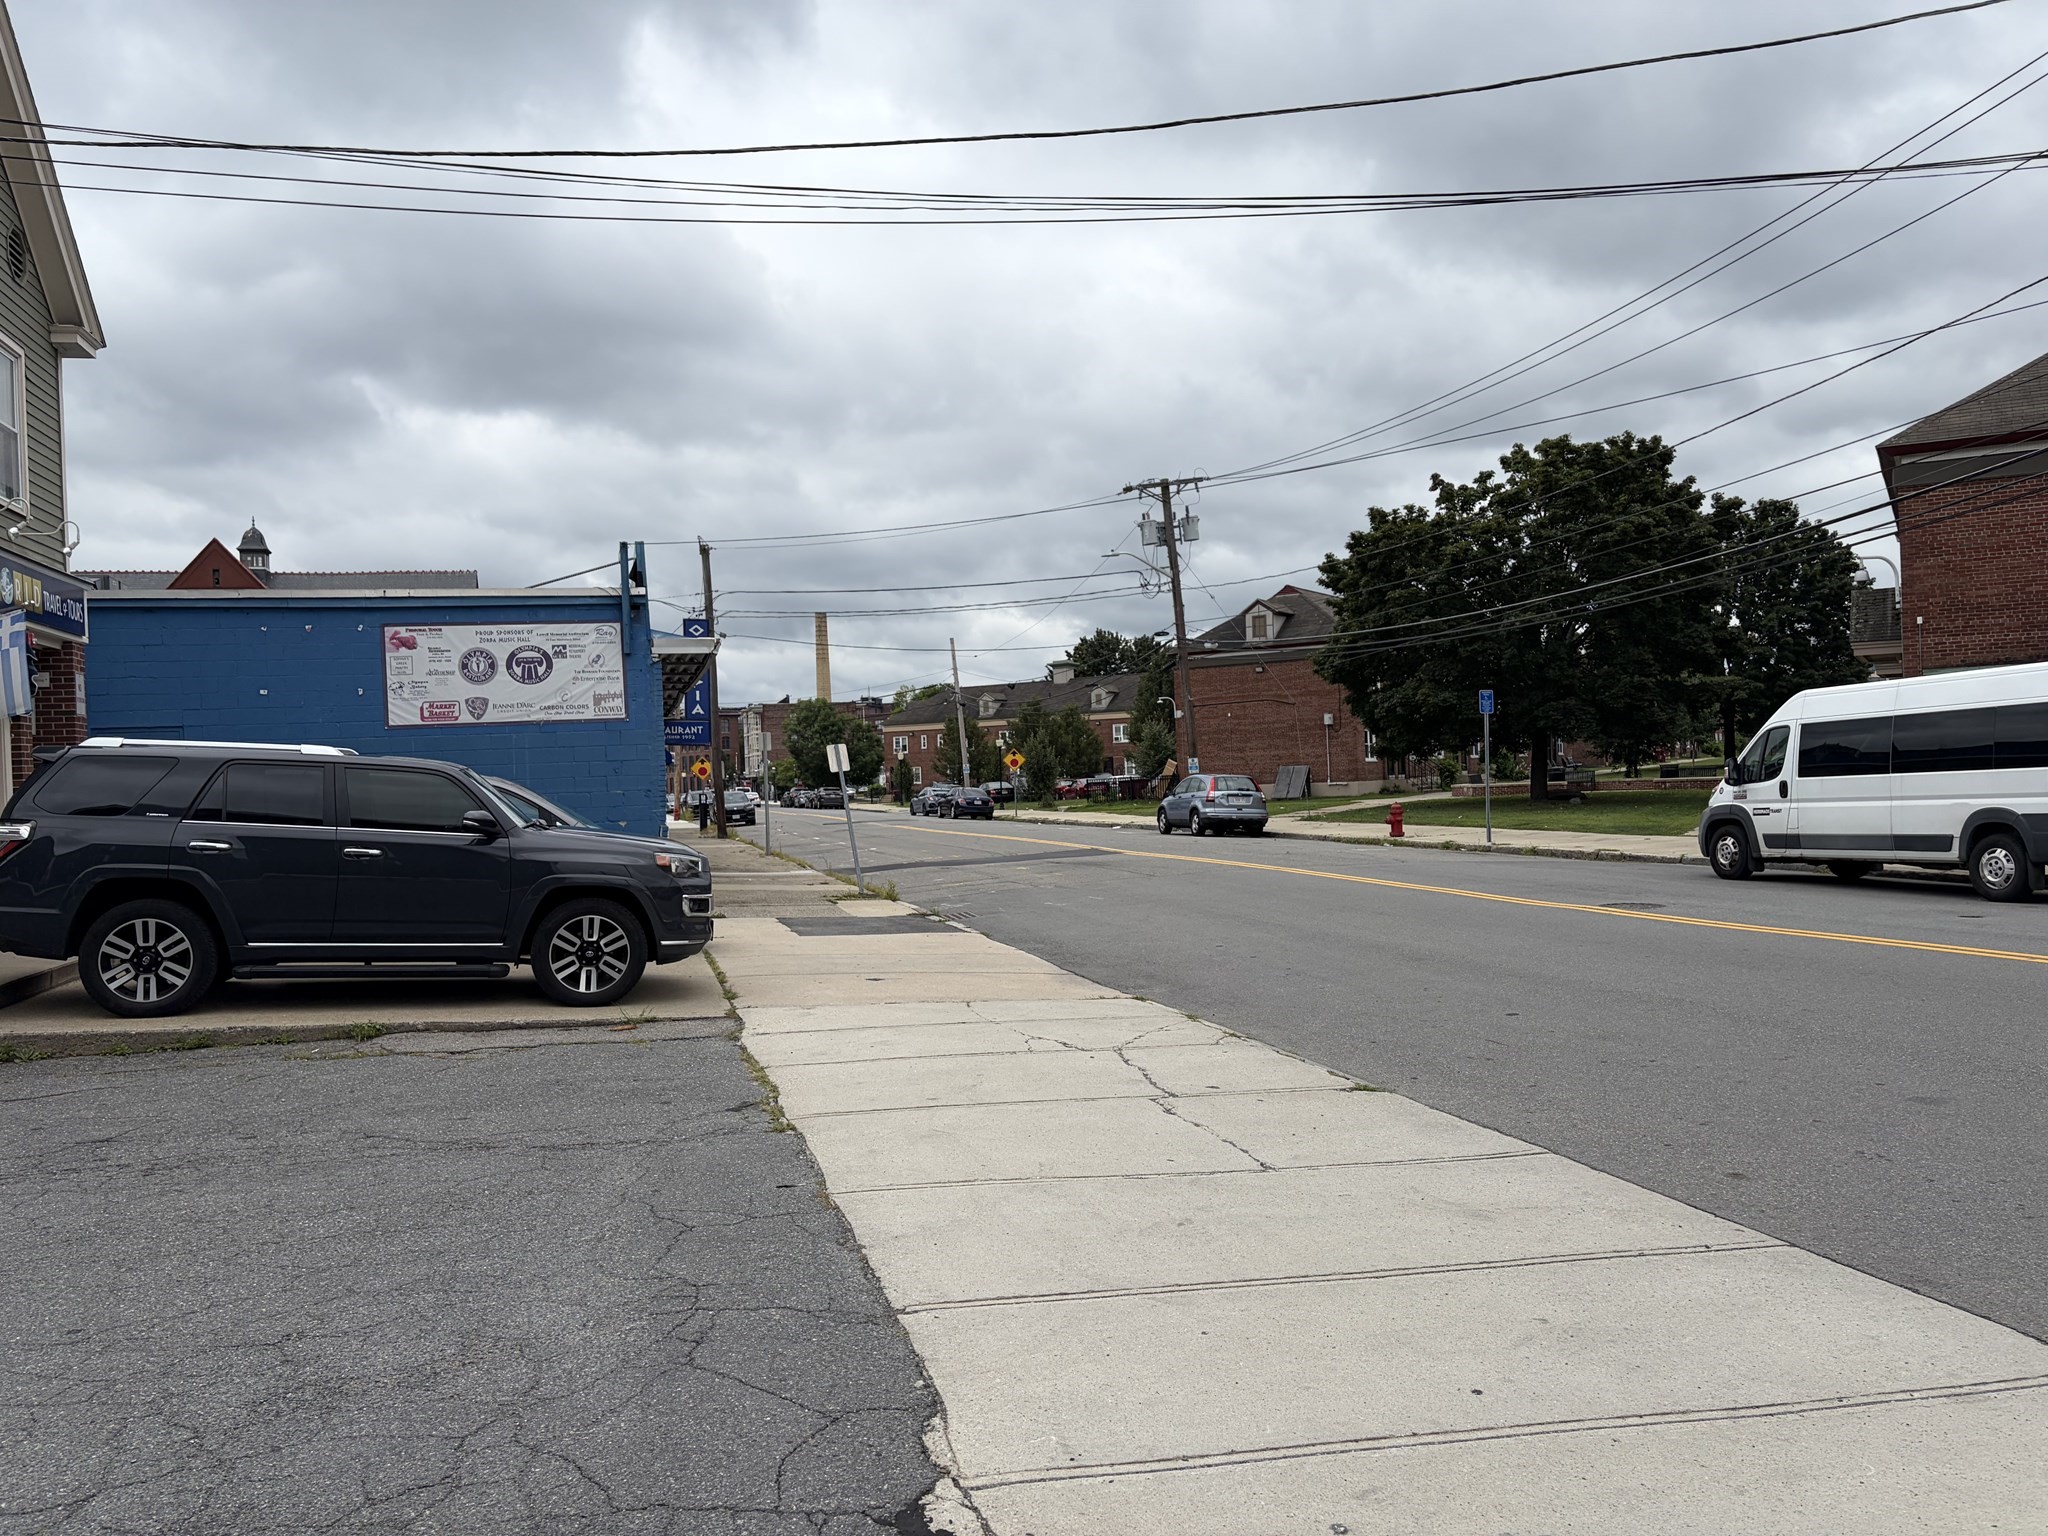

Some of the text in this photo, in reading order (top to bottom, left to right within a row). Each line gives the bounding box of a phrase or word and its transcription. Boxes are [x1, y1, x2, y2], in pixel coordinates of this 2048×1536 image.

[43, 590, 63, 616] TRAVEL
[67, 598, 84, 623] TOURS
[463, 651, 493, 664] OLYMPIA
[492, 703, 515, 711] JEANNE
[593, 705, 623, 713] CONWAY
[664, 726, 703, 734] AURANT
